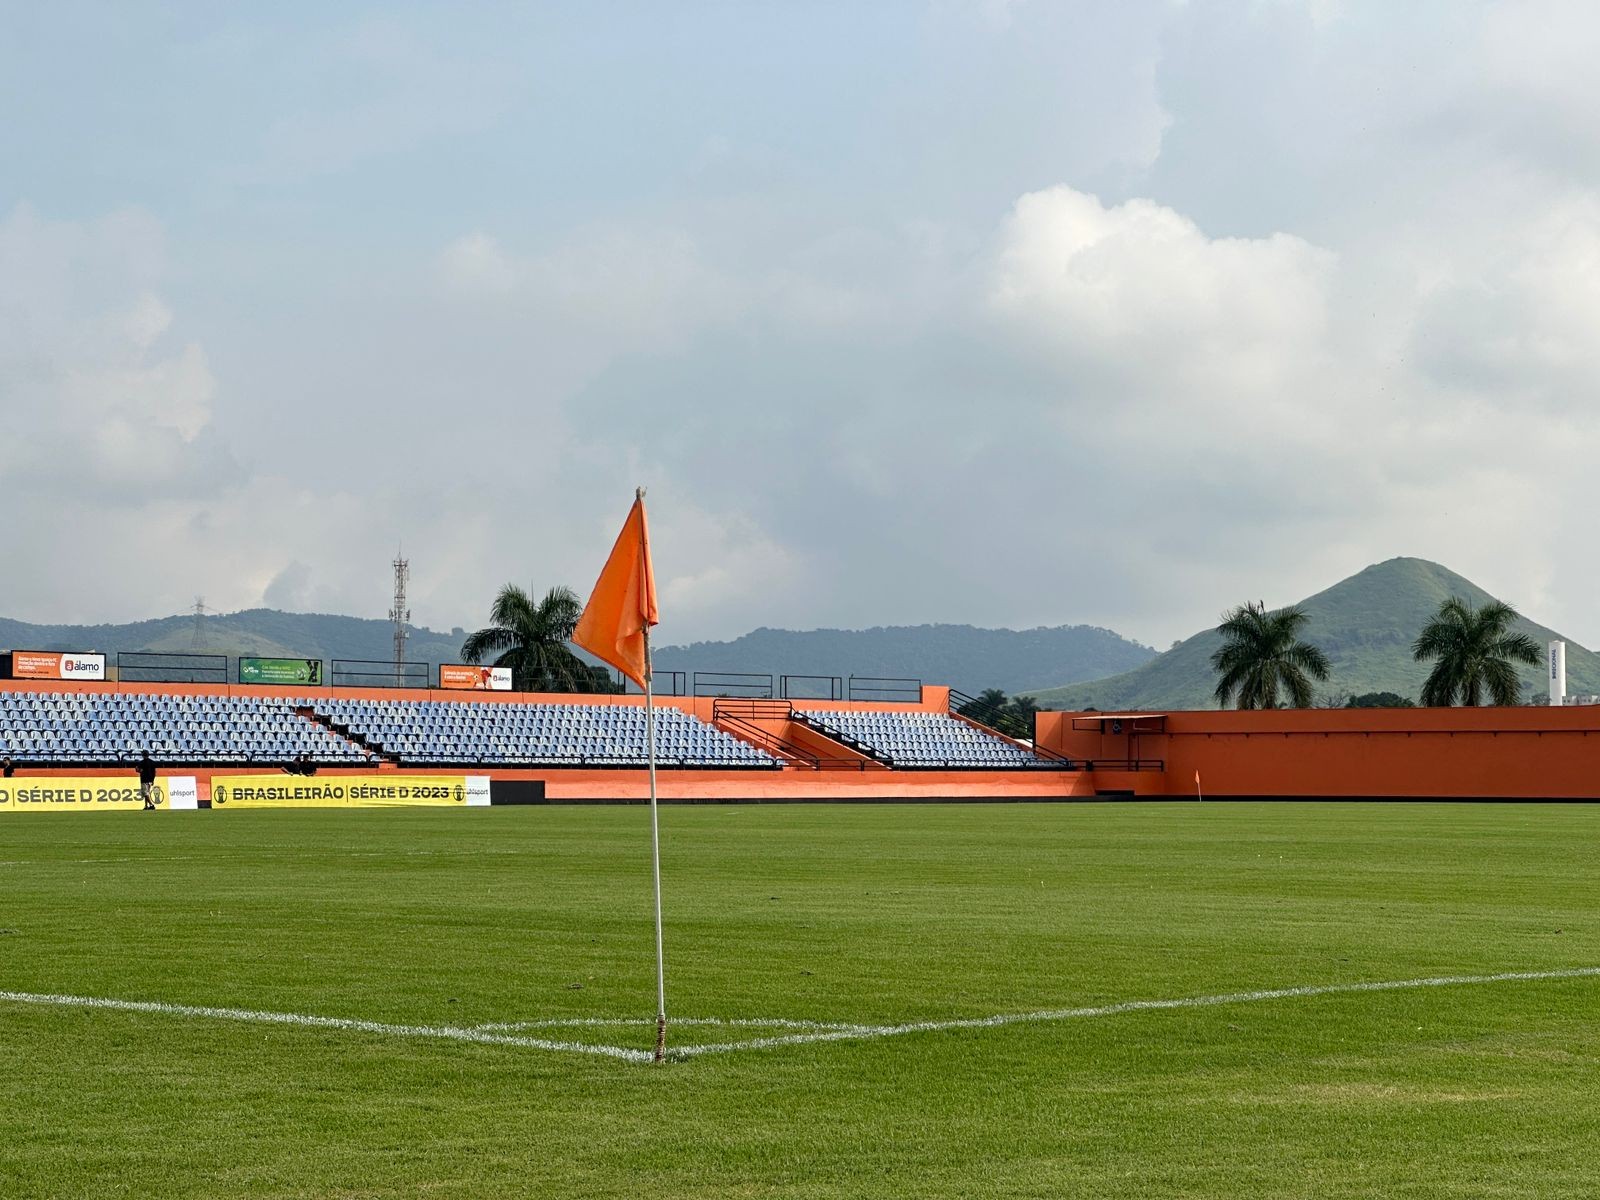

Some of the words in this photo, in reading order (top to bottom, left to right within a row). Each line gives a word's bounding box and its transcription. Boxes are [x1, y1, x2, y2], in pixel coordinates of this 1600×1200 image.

[74, 659, 99, 671] álamo
[17, 786, 76, 803] SÉRIE
[80, 789, 92, 802] D
[96, 789, 145, 802] 2023
[170, 789, 195, 798] uhlsport
[232, 783, 343, 801] BRASILEIRÃO
[350, 783, 395, 799] SÉRIE
[399, 786, 408, 799] D
[412, 786, 449, 798] 2023
